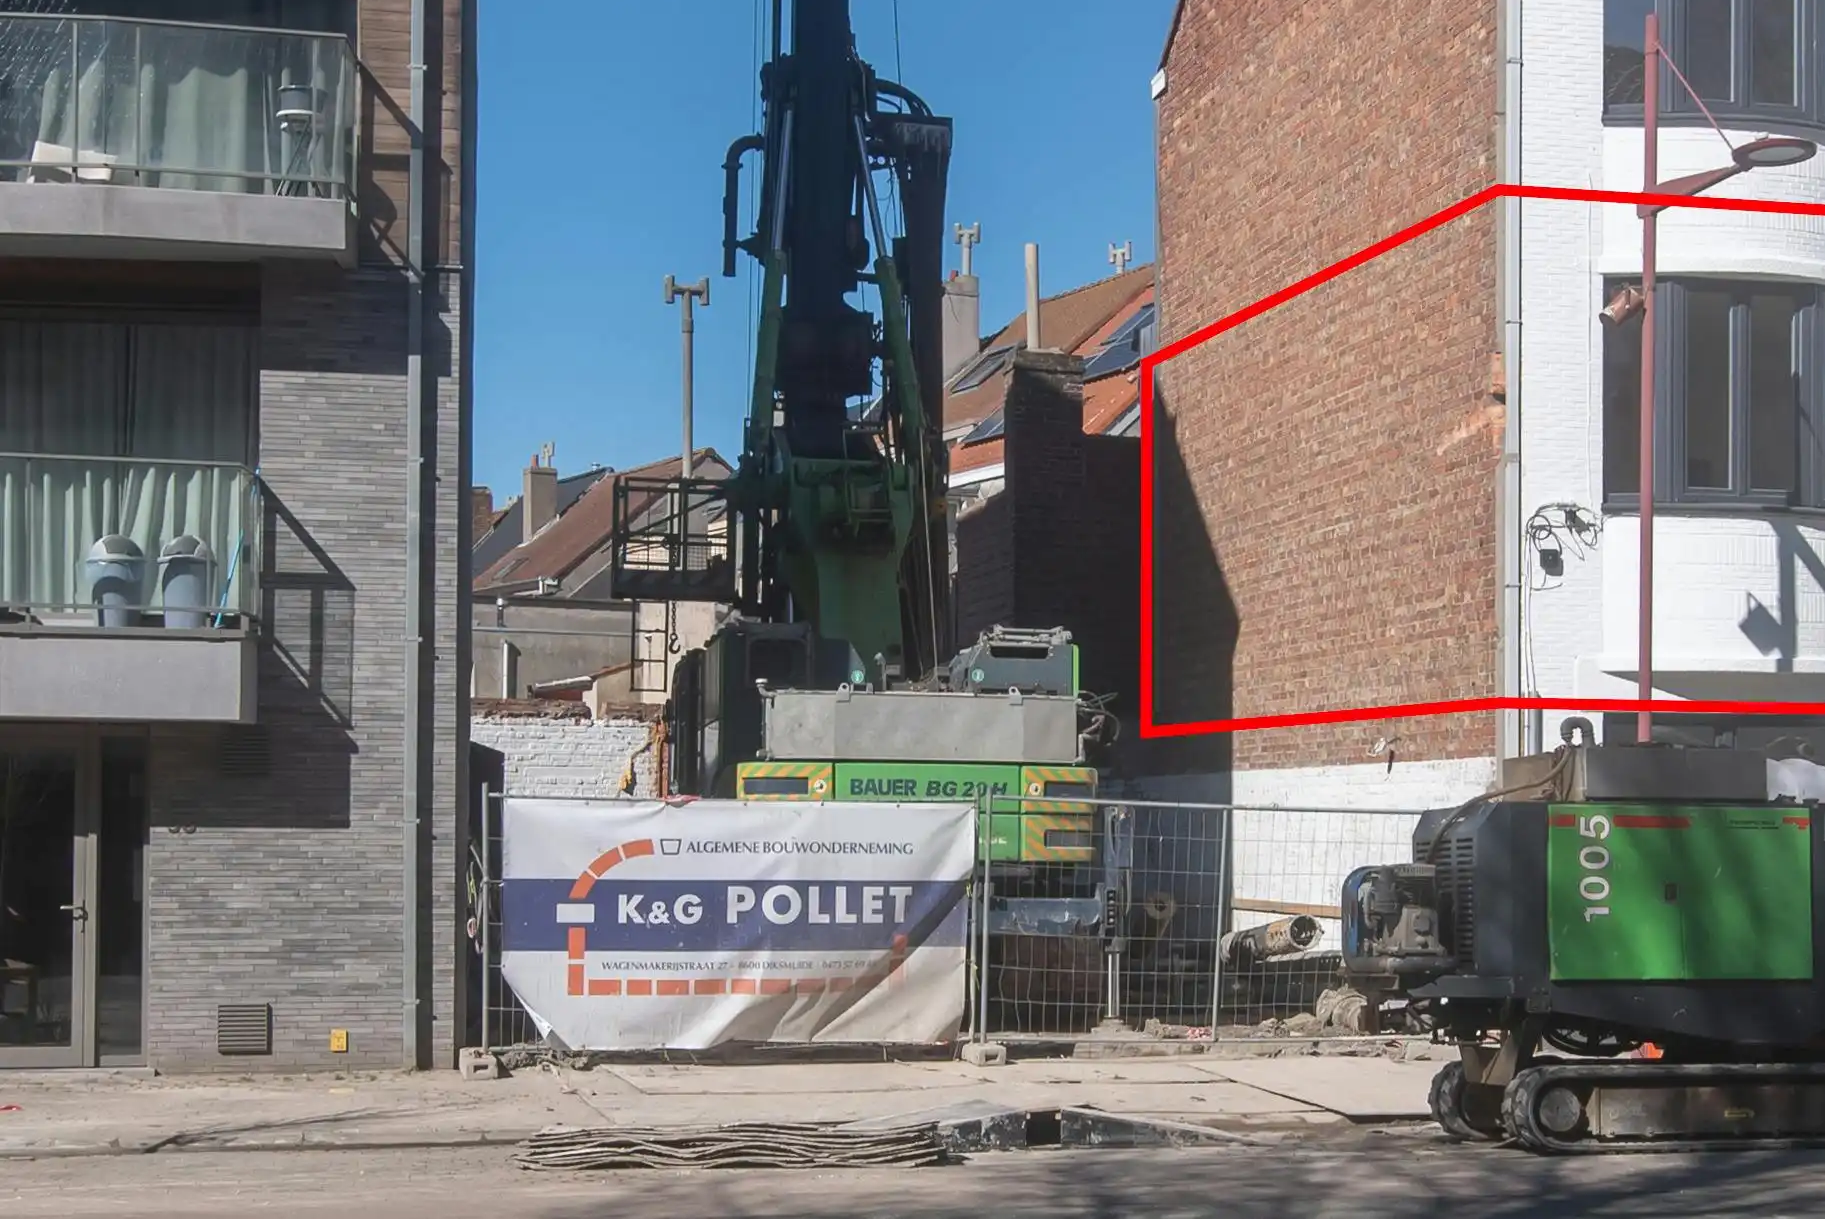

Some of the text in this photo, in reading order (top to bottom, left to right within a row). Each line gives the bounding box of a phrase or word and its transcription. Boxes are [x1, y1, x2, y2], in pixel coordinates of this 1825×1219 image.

[850, 779, 917, 796] BAUER
[926, 781, 957, 797] BG
[686, 841, 914, 855] ALGEMENE BOUWONDERNEMING
[1579, 814, 1611, 923] 1005
[618, 885, 914, 925] K&G POLLET
